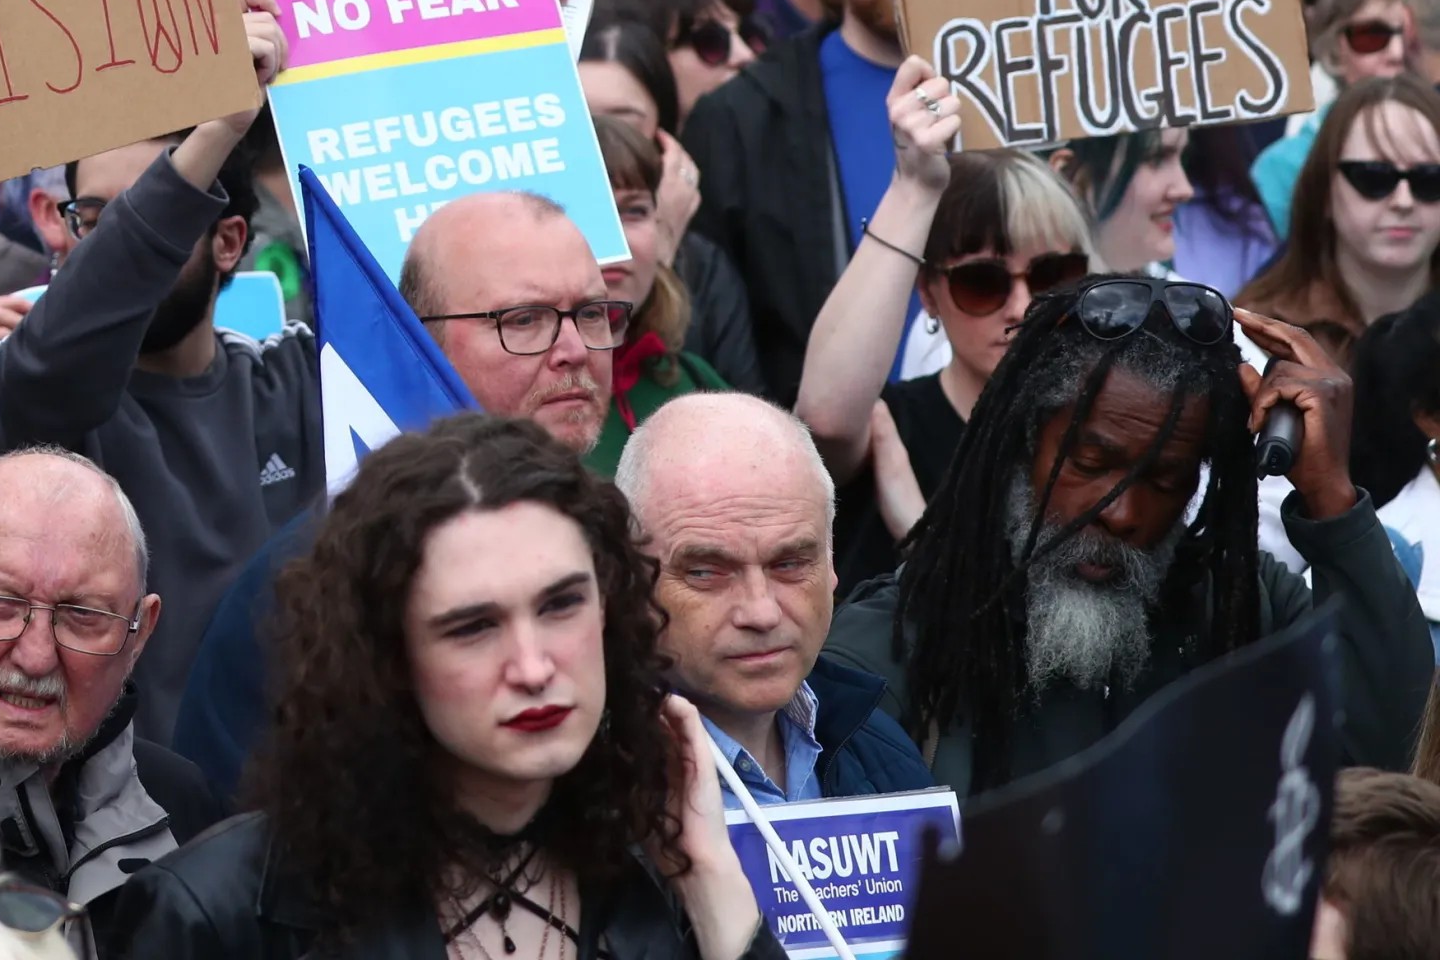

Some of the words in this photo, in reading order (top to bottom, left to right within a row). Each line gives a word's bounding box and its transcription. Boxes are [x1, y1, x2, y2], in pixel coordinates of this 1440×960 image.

[306, 93, 566, 165] REFUGEES
[318, 138, 566, 206] WELCOME
[766, 831, 899, 883] NASUWT
[773, 887, 799, 904] The
[810, 880, 862, 901] achers'
[865, 877, 903, 895] Union
[777, 909, 848, 934] NORTHRN
[850, 904, 905, 927] IRELAND
